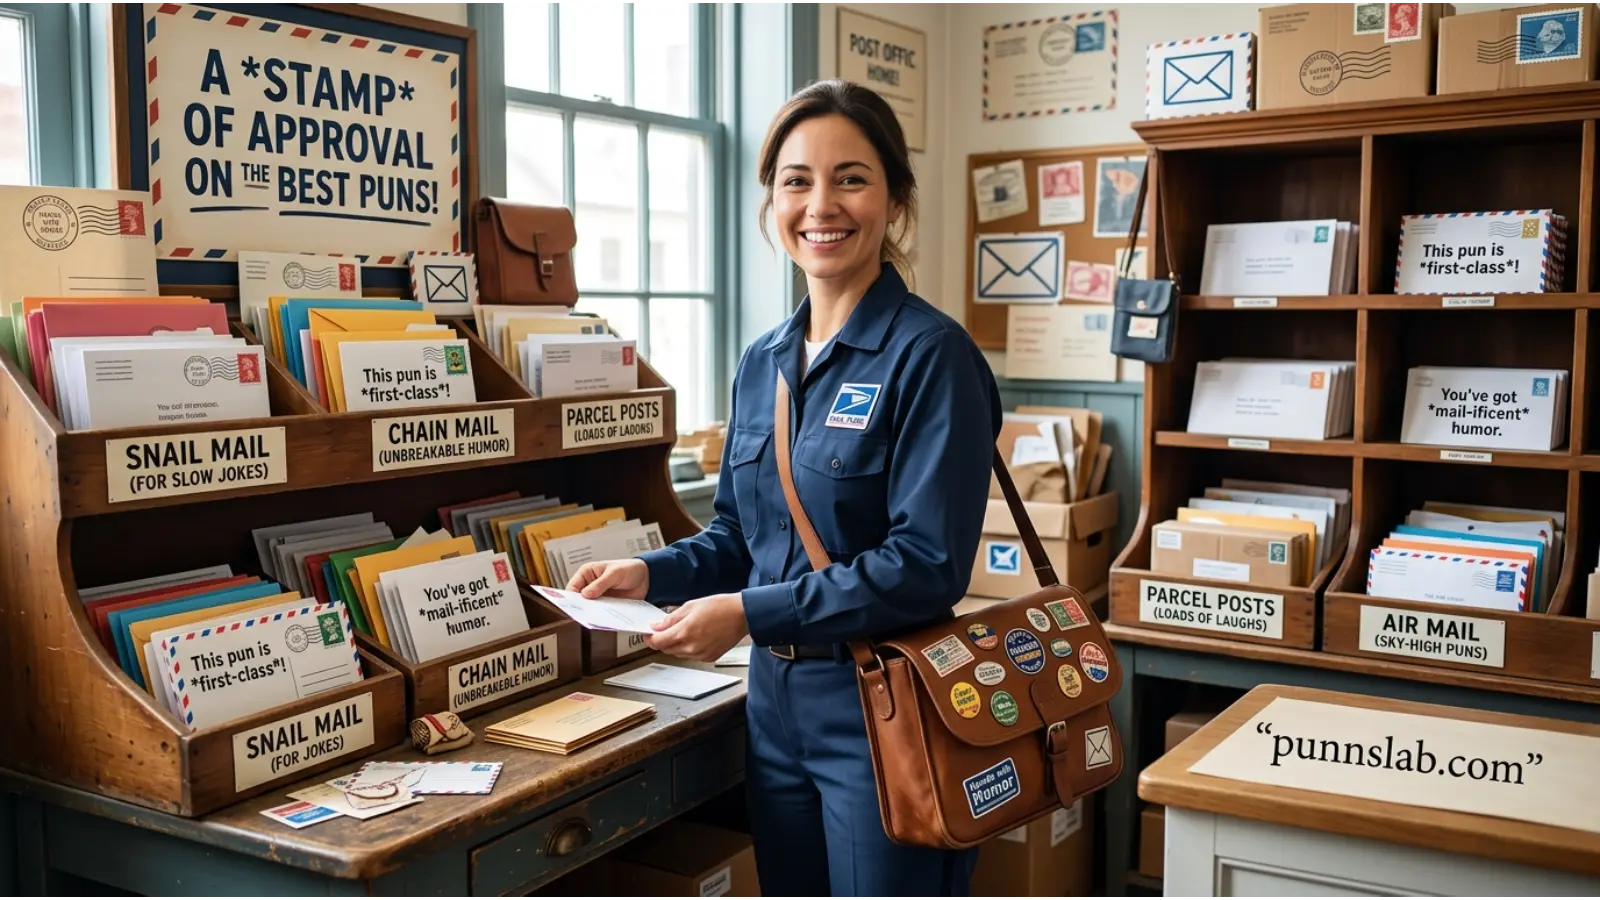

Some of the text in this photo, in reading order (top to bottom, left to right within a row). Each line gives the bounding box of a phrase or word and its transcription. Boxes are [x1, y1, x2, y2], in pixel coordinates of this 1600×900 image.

[850, 32, 880, 59] POST
[200, 48, 230, 96] A
[183, 102, 434, 170] OF APPROVAL
[184, 157, 439, 215] ON THE BEST PUNS!
[1423, 243, 1504, 260] This pun is
[363, 365, 437, 385] This pun is
[1441, 388, 1518, 406] You've got
[567, 401, 659, 426] PARCEL POSTS
[388, 415, 499, 445] CHAIN MAIL
[607, 425, 618, 438] OF
[1451, 421, 1502, 436] humor.
[126, 435, 270, 470] SNAIL MAIL
[379, 438, 510, 466] (UNBREAKABLE HUMOR)
[130, 462, 268, 494] (FOR SLOW JOKES)
[423, 576, 490, 602] You've got
[1147, 585, 1275, 617] PARCEL POSTS
[1154, 607, 1267, 632] (LOADS OF LAUGHS)
[1382, 613, 1480, 642] AIR MAIL
[190, 641, 271, 672] This pun is
[1375, 635, 1488, 661] (SKY-HIGH PUNS)
[459, 643, 549, 688] CHAIN MAIL
[522, 662, 554, 683] HUMOR)
[246, 703, 363, 760] SNAIL MAIL
[271, 734, 344, 774] (FOR JOKES)
